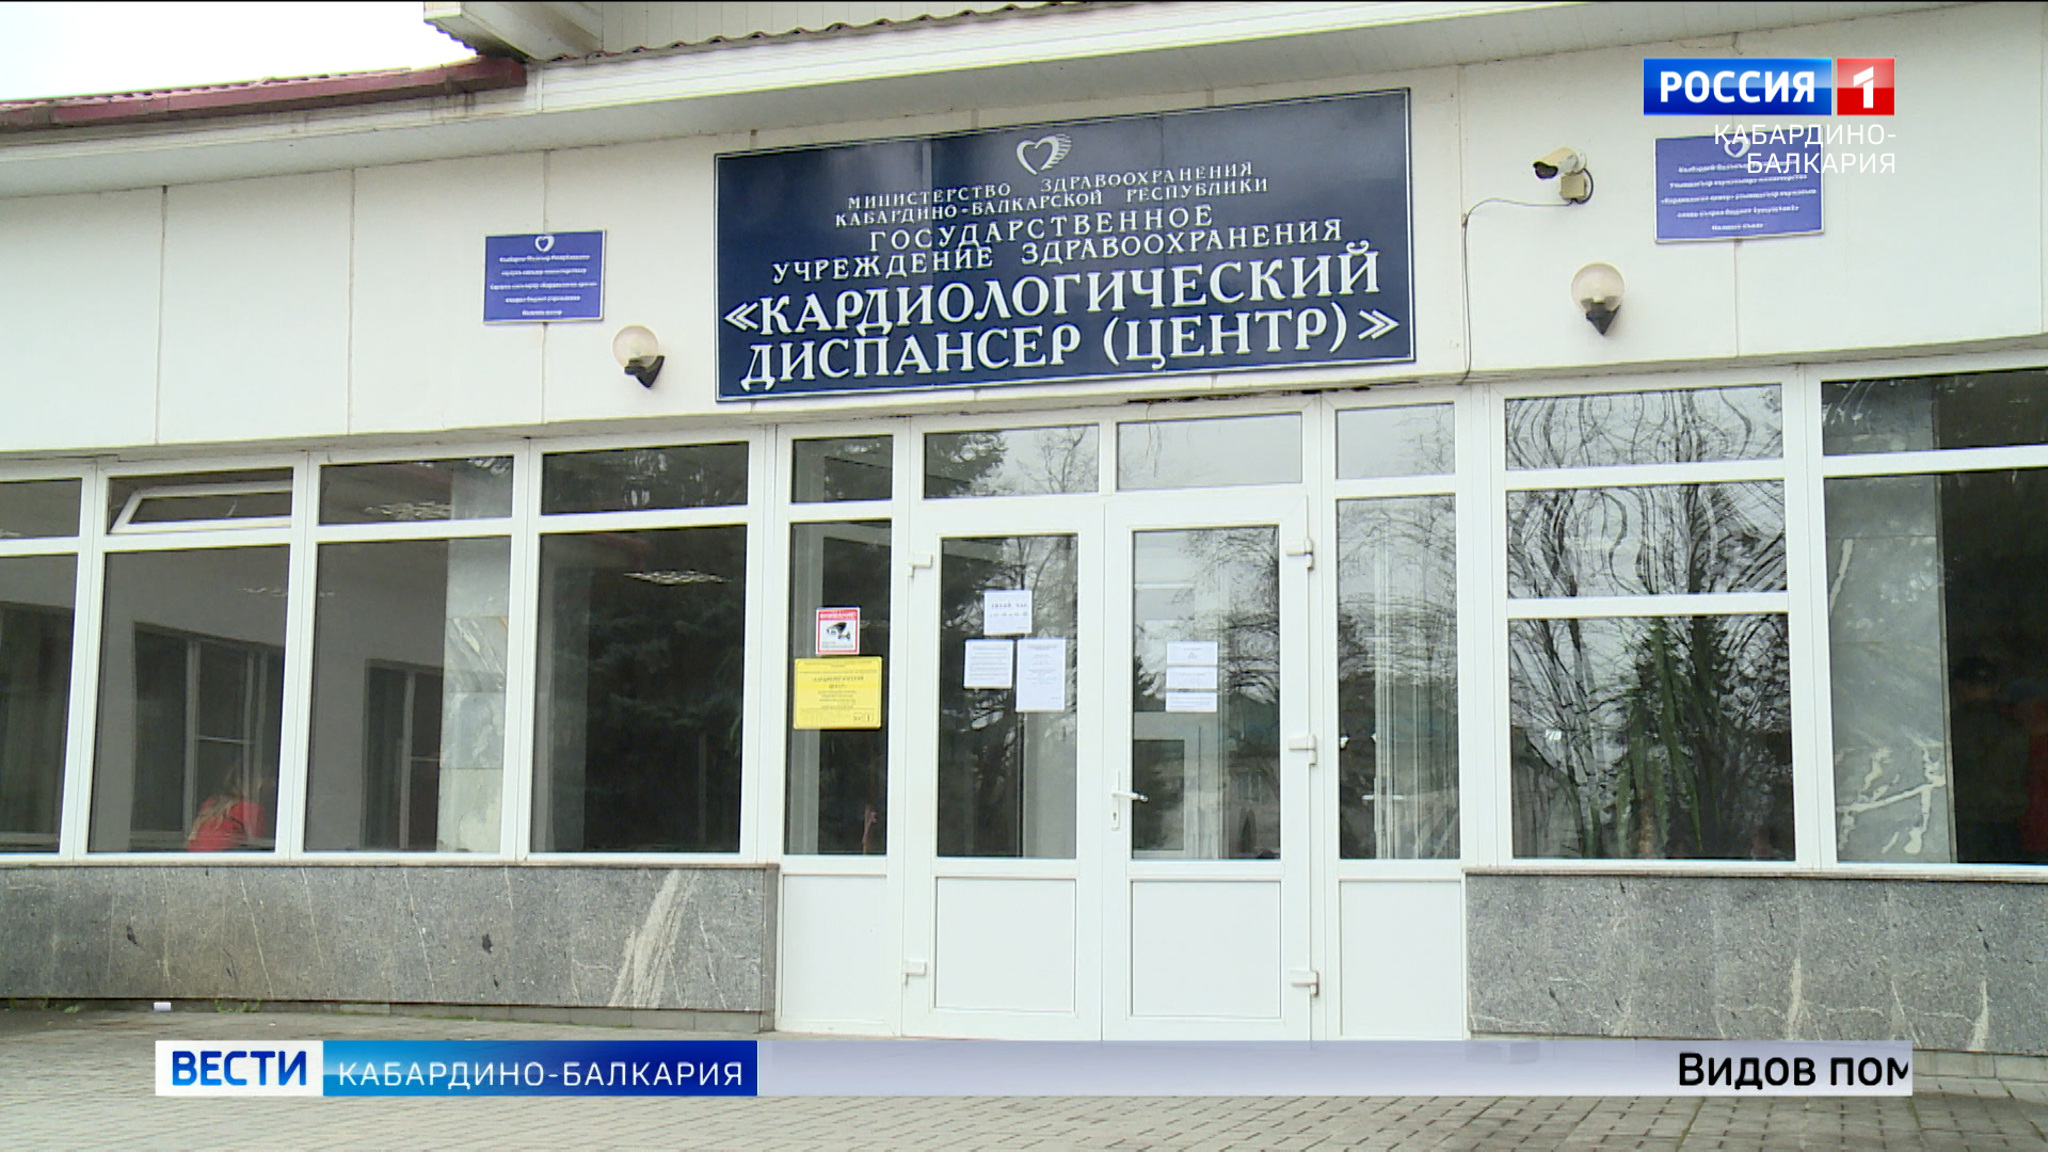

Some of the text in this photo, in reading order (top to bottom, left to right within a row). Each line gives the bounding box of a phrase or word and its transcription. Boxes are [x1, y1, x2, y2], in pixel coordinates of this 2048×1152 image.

[835, 177, 1269, 227] КАБАРДИНО-БАЛКАРСКОЙ РЕСПУБЛИКИ
[848, 161, 1253, 210] МИНИСТЕРСТВО ЗДРАВООХРАНЕНИЯ
[772, 218, 1342, 284] УЧРЕЖДЕНИЕ ЗДРАВООХРАНЕНИЯ
[869, 204, 1212, 252] ГОСУДАРСТВЕННОЕ
[724, 240, 1380, 336] «КАРДИОЛОГИЧЕСКИЙ
[739, 301, 1400, 391] ДИСПАНСЕР (ЦЕНТР)»
